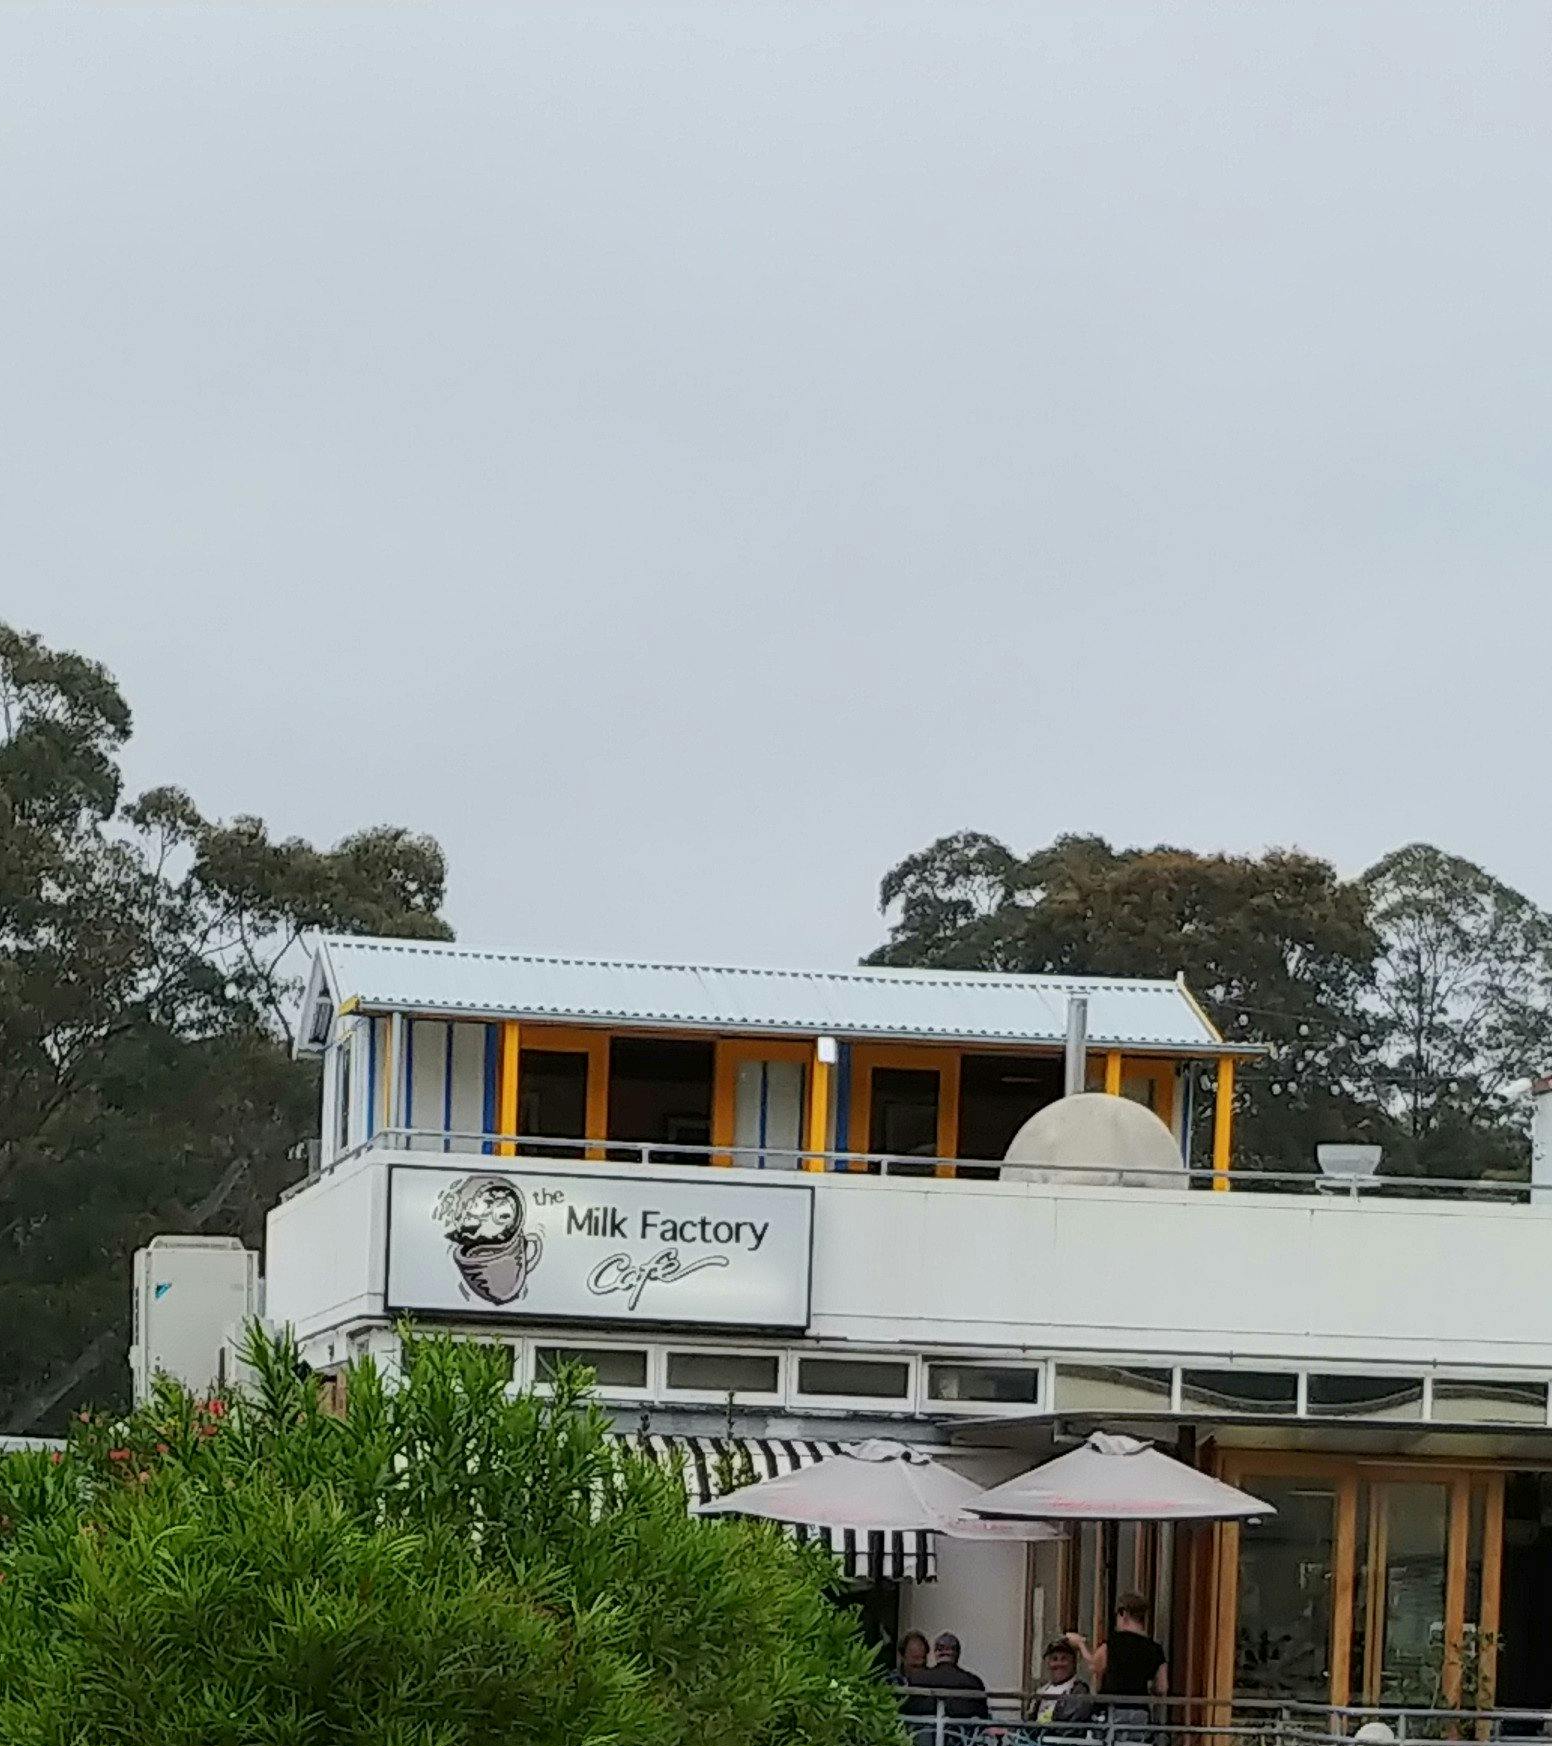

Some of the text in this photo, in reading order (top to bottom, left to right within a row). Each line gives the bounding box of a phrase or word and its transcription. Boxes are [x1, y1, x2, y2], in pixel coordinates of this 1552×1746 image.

[532, 1187, 769, 1252] the Milk Factory
